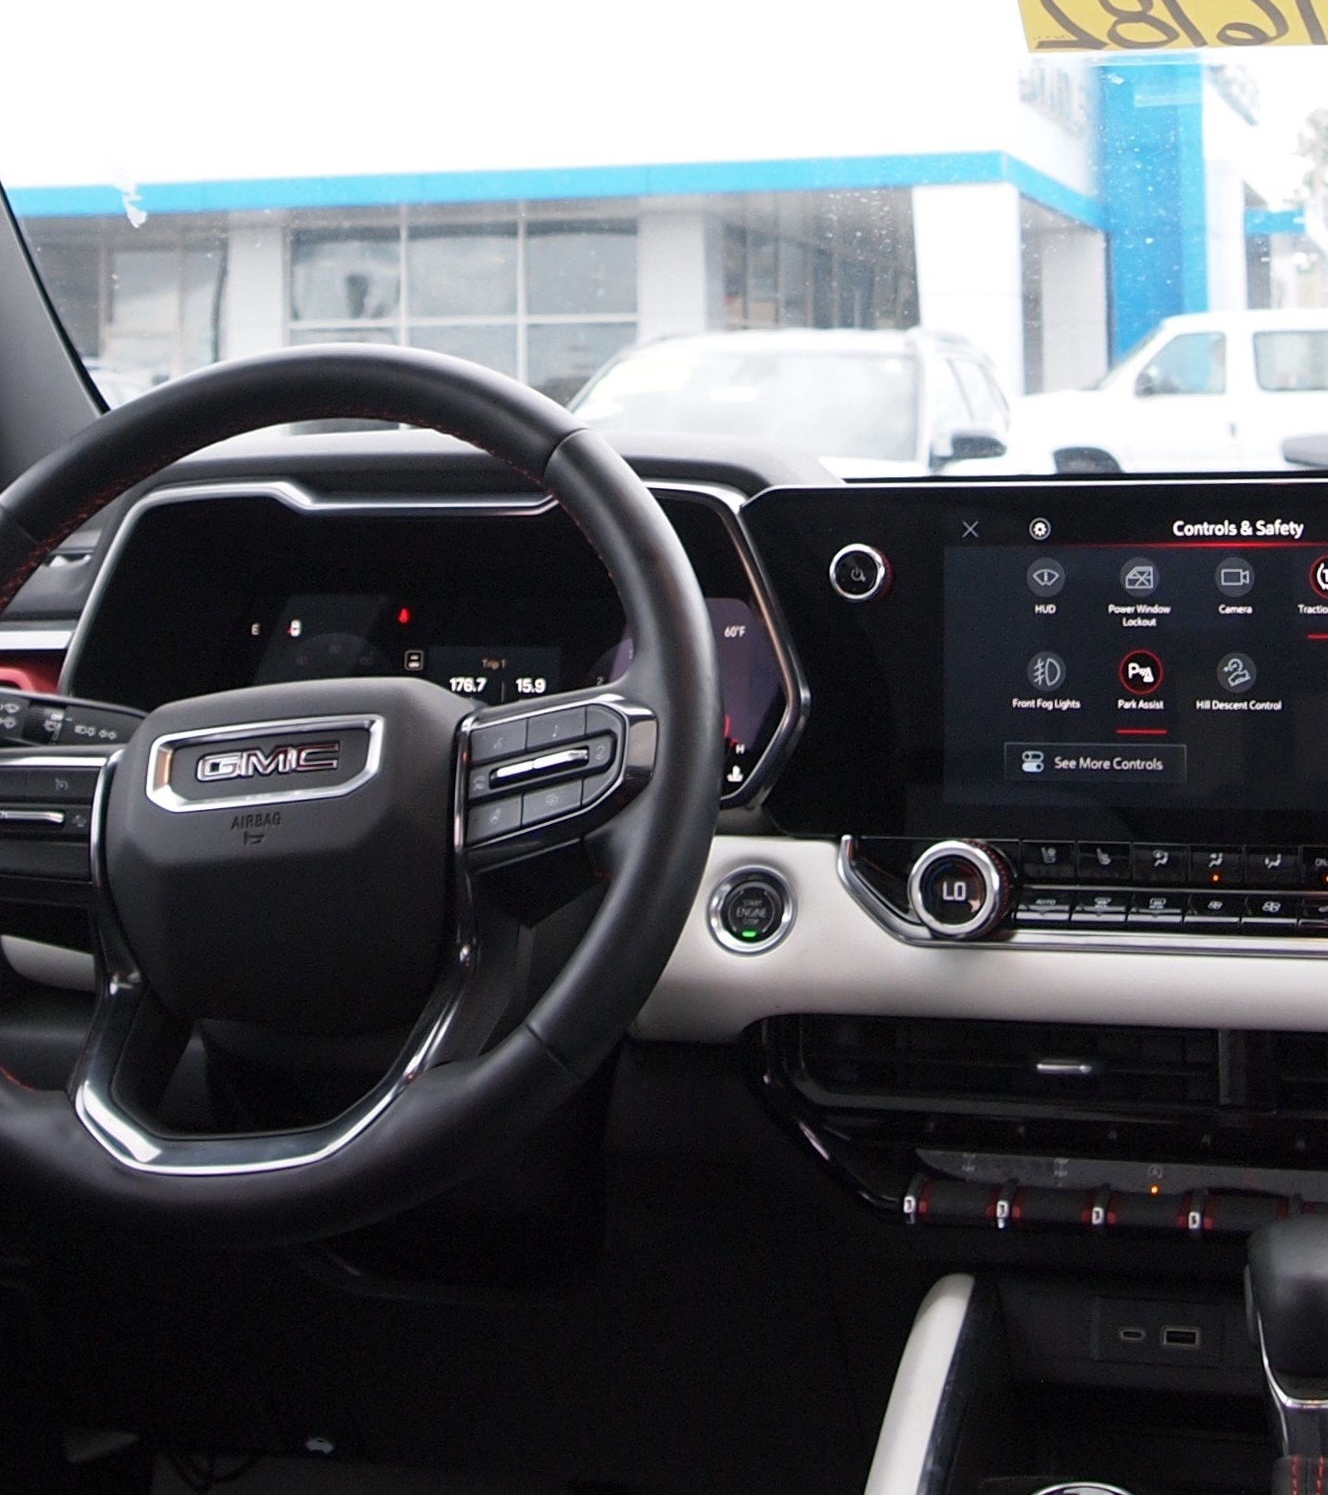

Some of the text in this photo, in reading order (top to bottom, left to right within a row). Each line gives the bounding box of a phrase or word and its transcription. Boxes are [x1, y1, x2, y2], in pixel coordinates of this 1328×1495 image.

[1173, 520, 1304, 539] Controls & Safety
[1035, 604, 1056, 615] HUD
[1108, 604, 1171, 615] Power Window
[1219, 604, 1252, 615] Camera
[1123, 617, 1157, 627] Lockout
[449, 677, 546, 694] 176.7 15.9
[1012, 697, 1081, 712] Front Fog Lights
[1118, 699, 1164, 710] Park Assist
[1196, 700, 1282, 711] Hill Descent Control
[197, 742, 340, 782] GMC
[1054, 757, 1163, 771] See More Controls
[232, 812, 282, 830] AIRBAG
